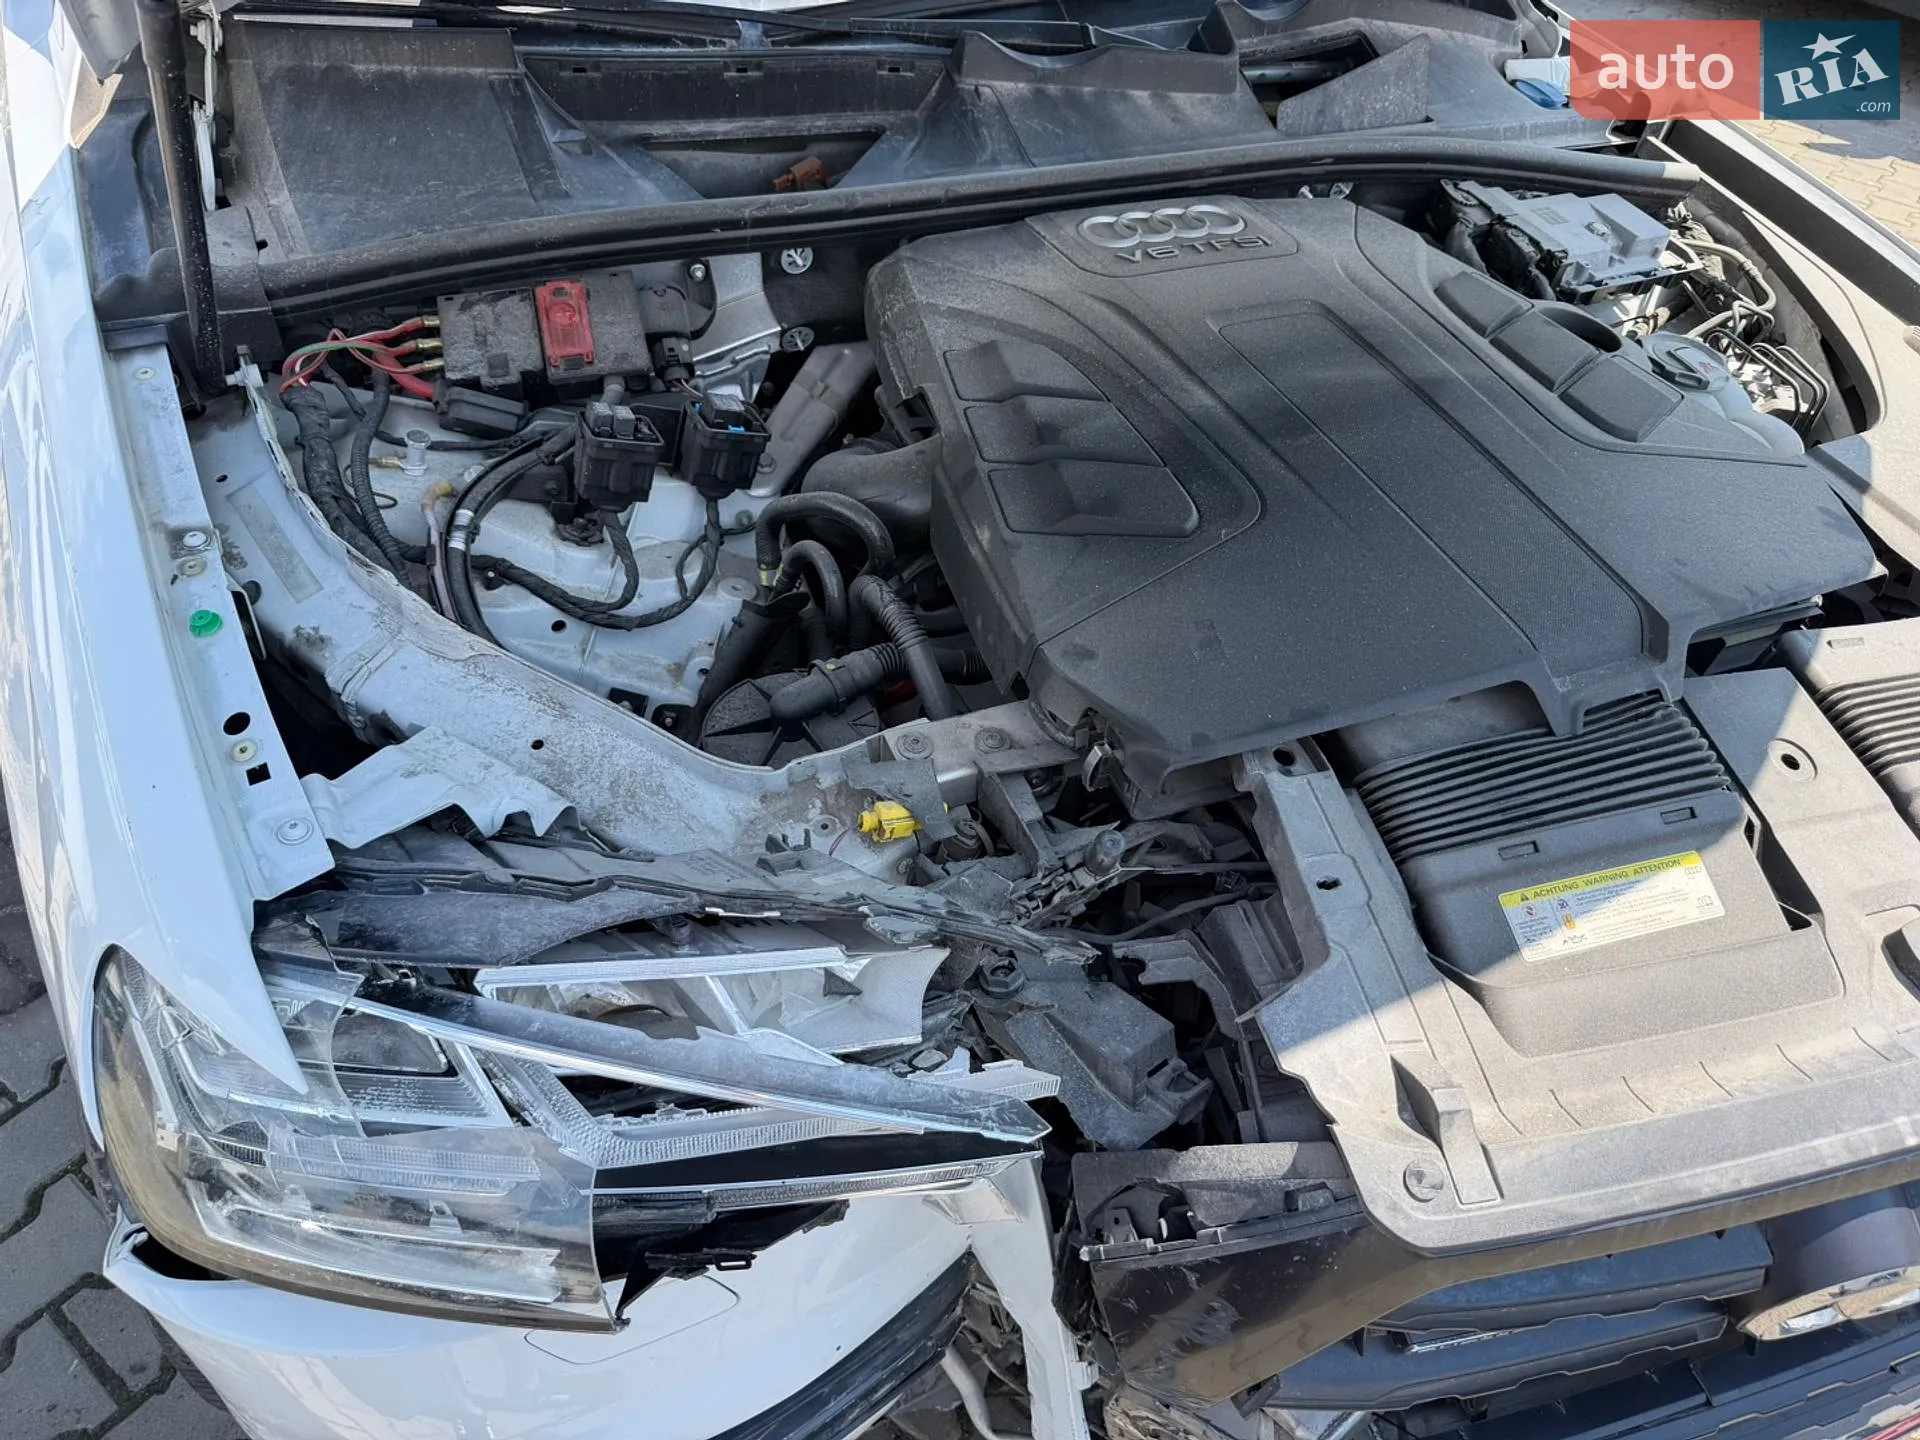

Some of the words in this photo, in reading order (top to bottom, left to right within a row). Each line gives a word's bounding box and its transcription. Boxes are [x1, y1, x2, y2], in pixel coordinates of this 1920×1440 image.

[1115, 245, 1179, 264] V6
[1183, 236, 1272, 253] TFSI
[1533, 881, 1579, 899] ACHTUNG
[1583, 870, 1629, 888] WARNING
[1633, 858, 1682, 876] ATTENTION
